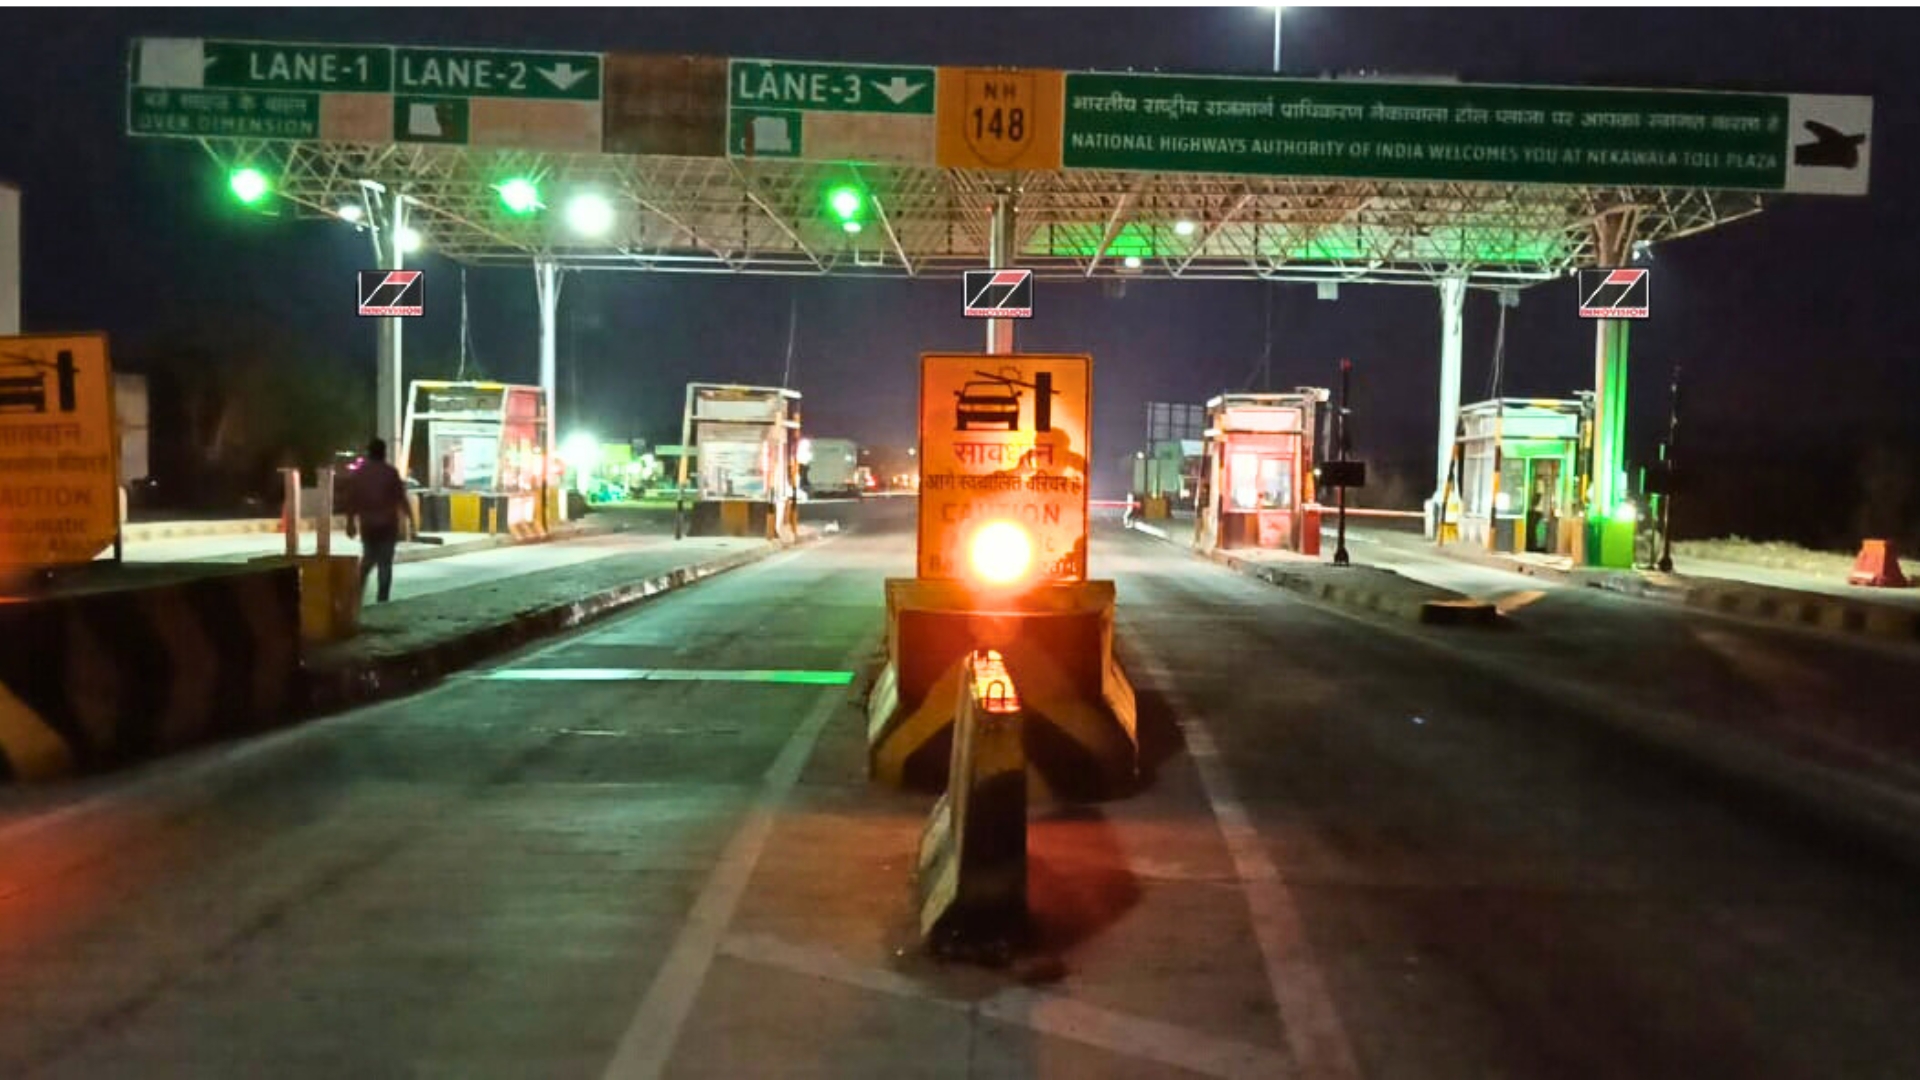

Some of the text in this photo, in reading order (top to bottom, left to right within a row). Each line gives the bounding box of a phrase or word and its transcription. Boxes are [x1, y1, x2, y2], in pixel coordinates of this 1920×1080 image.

[250, 52, 368, 82] LANE-1
[402, 57, 527, 88] LANE-2
[738, 70, 862, 103] LANE-3
[973, 108, 1024, 142] 148
[1072, 90, 1138, 112] भारतीय
[1551, 109, 1575, 127] पर
[1071, 132, 1777, 168] NATIONAL HIGHWAYS AUTHORITY OF INDIA WELCOMES YOU AT NEKAWALA TOLL PLAZA
